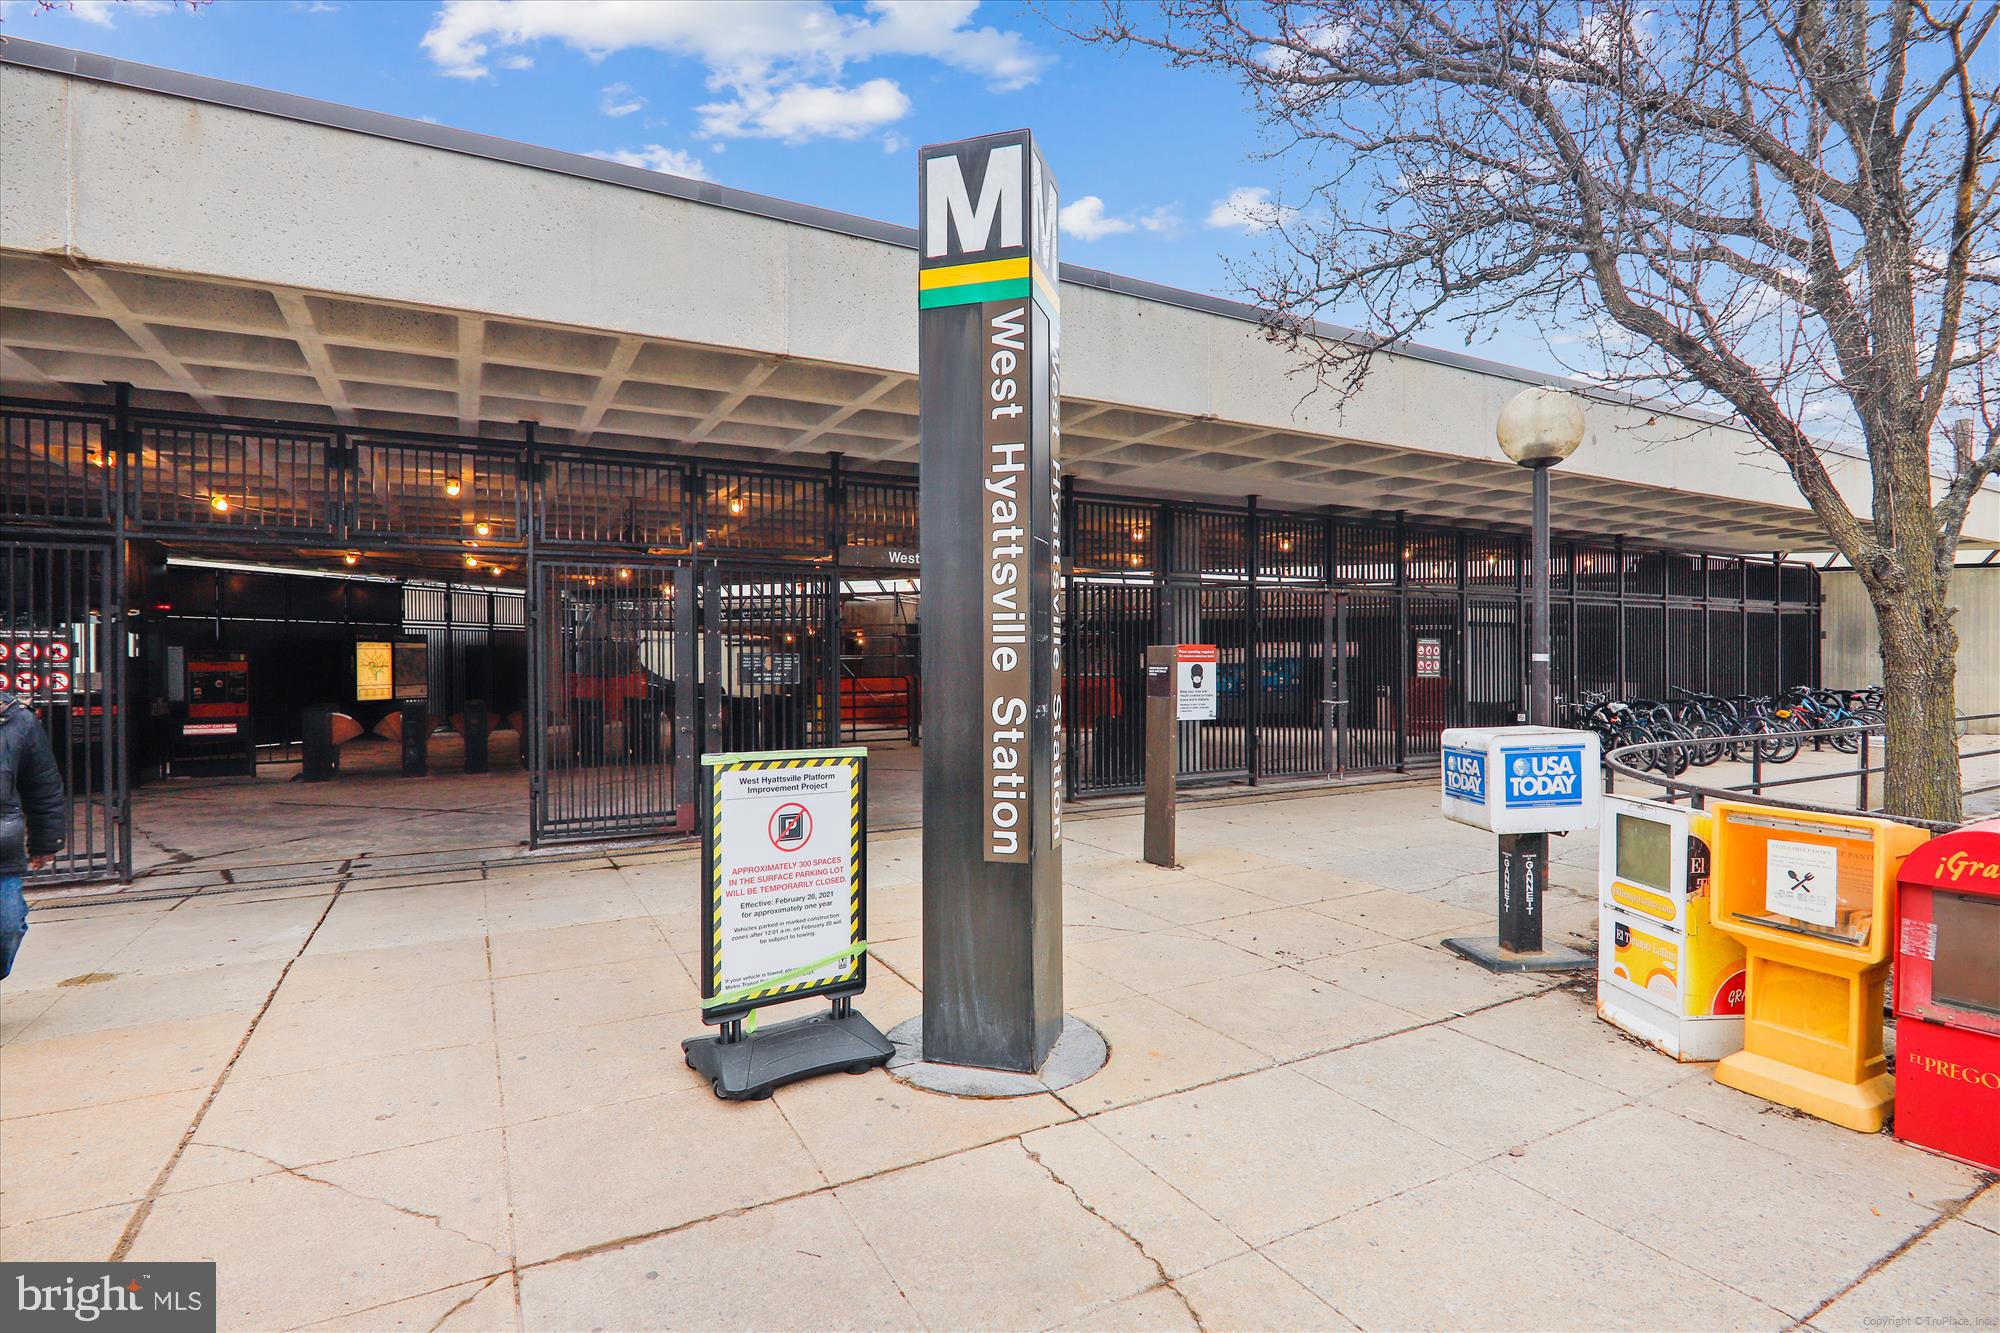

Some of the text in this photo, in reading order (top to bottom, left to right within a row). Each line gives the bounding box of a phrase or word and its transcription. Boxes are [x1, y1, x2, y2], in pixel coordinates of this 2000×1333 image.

[926, 143, 1023, 258] M
[889, 551, 920, 564] West
[984, 306, 1028, 854] West Hyattsville Station
[1052, 694, 1062, 840] Station
[1457, 755, 1481, 778] USA
[1531, 755, 1574, 776] USA
[739, 773, 835, 785] West Hyattsville Platform
[747, 782, 828, 795] Improvement Project
[1446, 771, 1481, 793] TODAY
[1510, 775, 1577, 796] TODAY
[732, 857, 842, 875] APPROXIMATELY 300 SPACES
[1690, 857, 1705, 874] El
[725, 888, 745, 897] WILL
[760, 881, 813, 893] TEMPORARILY
[815, 876, 847, 885] CLOSED.
[729, 878, 737, 886] IN
[740, 876, 755, 884] THE
[757, 873, 793, 883] SURFACE
[795, 868, 828, 878] PARKING
[1503, 858, 1511, 914] GANNETT
[1525, 860, 1534, 916] GANNETT
[740, 900, 773, 909] Effective:
[775, 895, 805, 905] February
[807, 893, 817, 901] 20,
[741, 910, 752, 918] for
[754, 904, 802, 917] approximately
[819, 901, 833, 909] year
[734, 925, 757, 933] Vehicles
[758, 922, 778, 930] parked
[807, 913, 840, 922] construction
[750, 931, 763, 939] after
[801, 922, 824, 930] February
[768, 934, 789, 943] subject
[797, 931, 816, 940] towing.
[1616, 928, 1624, 941] El
[1625, 931, 1651, 953] Tiempo
[1909, 1053, 2000, 1090] EL PREGO
